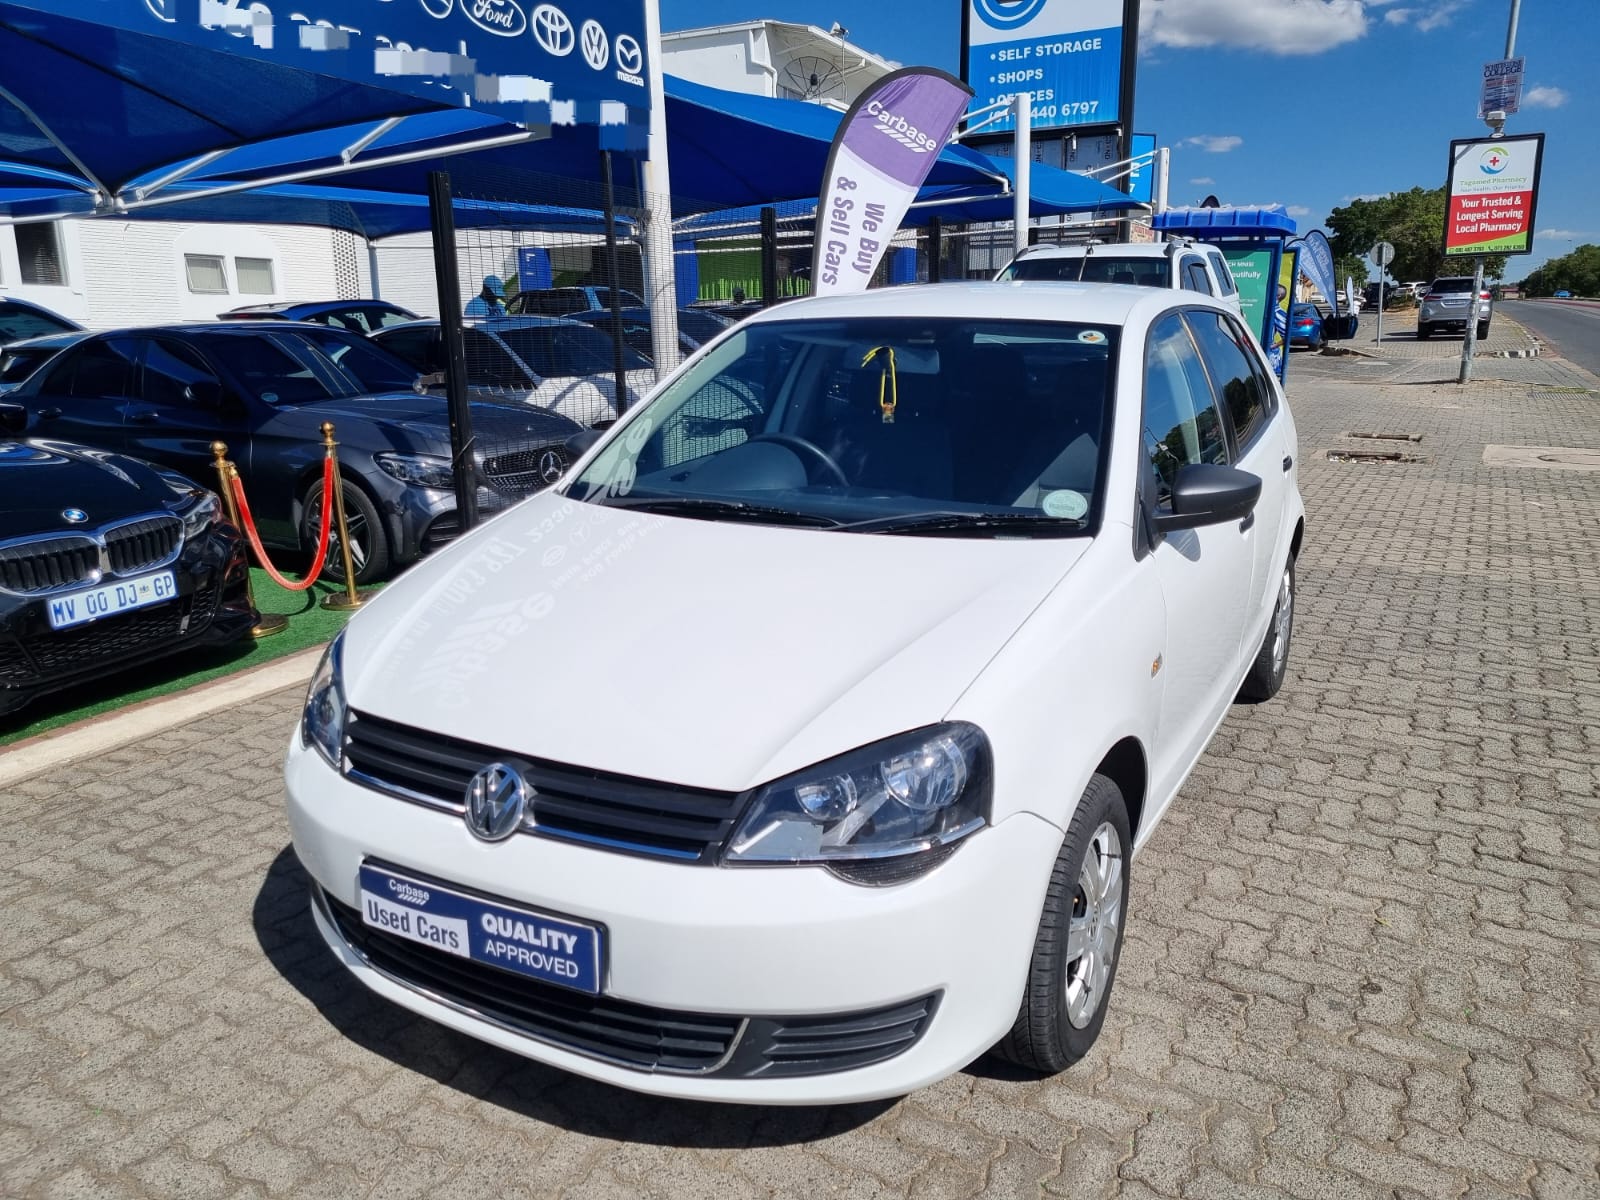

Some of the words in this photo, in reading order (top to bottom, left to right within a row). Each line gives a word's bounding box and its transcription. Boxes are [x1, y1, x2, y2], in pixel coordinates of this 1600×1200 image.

[473, 0, 514, 28] Ford
[998, 47, 1031, 62] SELF
[1035, 38, 1102, 57] STORAGE
[997, 68, 1044, 84] SHOPS
[997, 89, 1054, 105] OFCES
[1061, 101, 1099, 116] 6797
[867, 100, 937, 151] Carbase
[837, 176, 857, 191] &
[1456, 210, 1489, 222] Longest
[1491, 209, 1524, 220] Serving
[1461, 199, 1480, 208] Your
[1482, 196, 1513, 207] Trusted
[1514, 195, 1522, 205] &
[830, 196, 854, 236] Sell
[862, 202, 886, 233] We
[1456, 224, 1478, 234] Local
[1480, 222, 1522, 232] Pharmacy
[822, 240, 847, 286] Cars
[852, 239, 879, 275] Buy
[52, 600, 76, 625] MV
[116, 584, 138, 608] DJ
[154, 575, 173, 597] GP
[389, 879, 430, 901] Carbase
[367, 899, 411, 933] Used
[417, 916, 460, 949] Cars
[482, 913, 578, 954] QUALITY
[485, 940, 579, 979] APPROVED
